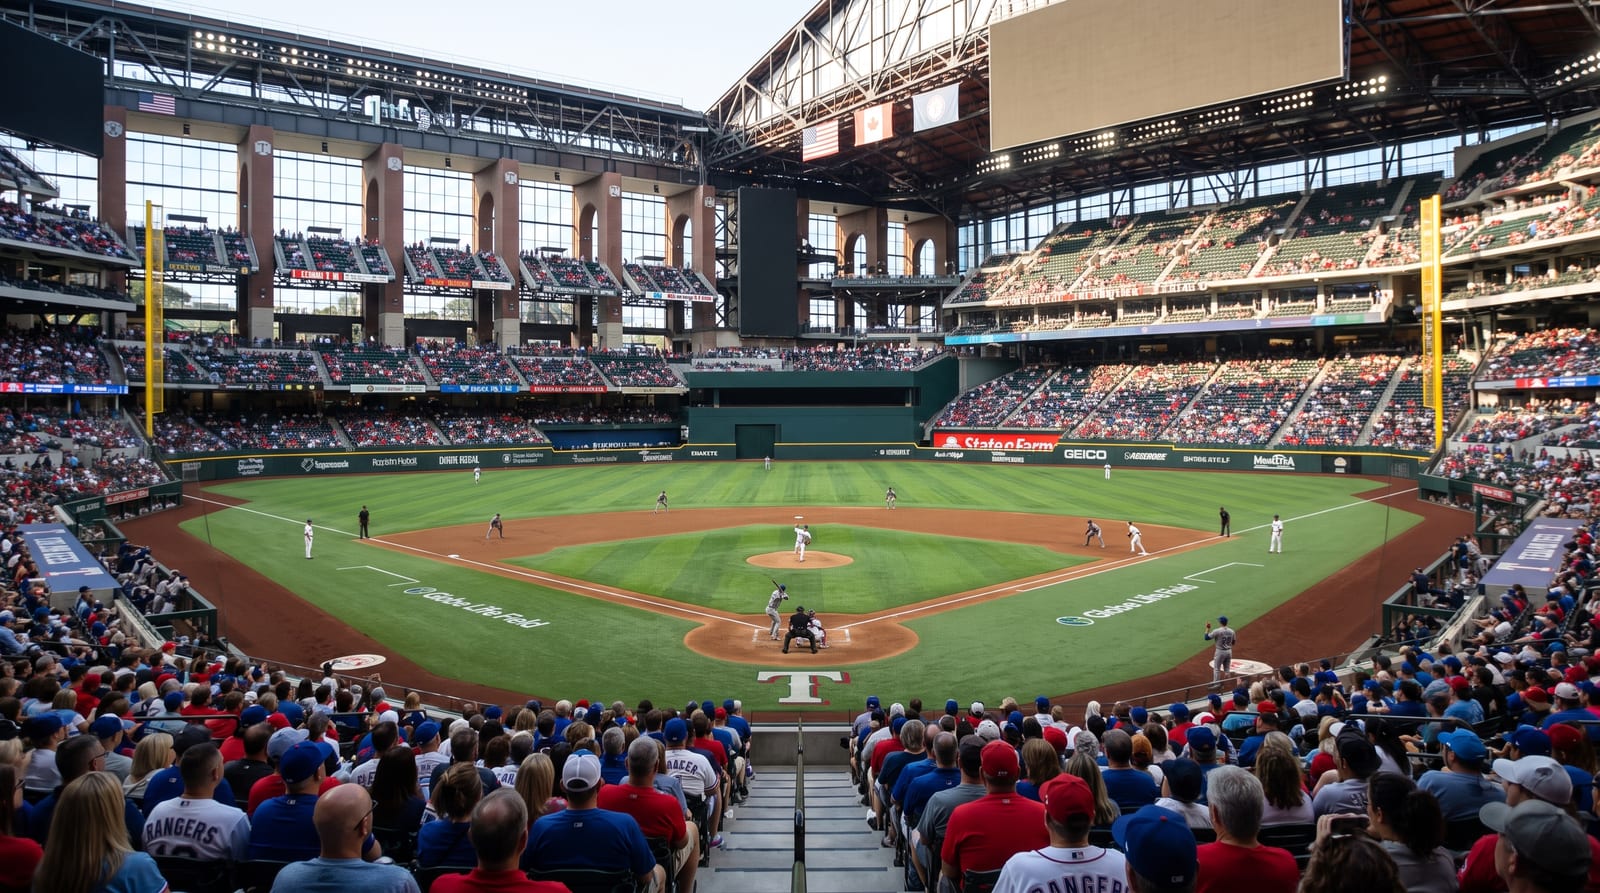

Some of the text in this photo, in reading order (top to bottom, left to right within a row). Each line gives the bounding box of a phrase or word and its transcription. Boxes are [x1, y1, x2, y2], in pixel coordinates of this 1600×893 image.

[1064, 449, 1107, 460] GEICO
[423, 592, 550, 629] Globe Life Field
[1083, 602, 1142, 618] Globe
[757, 671, 851, 706] T
[146, 817, 218, 844] RANGERS
